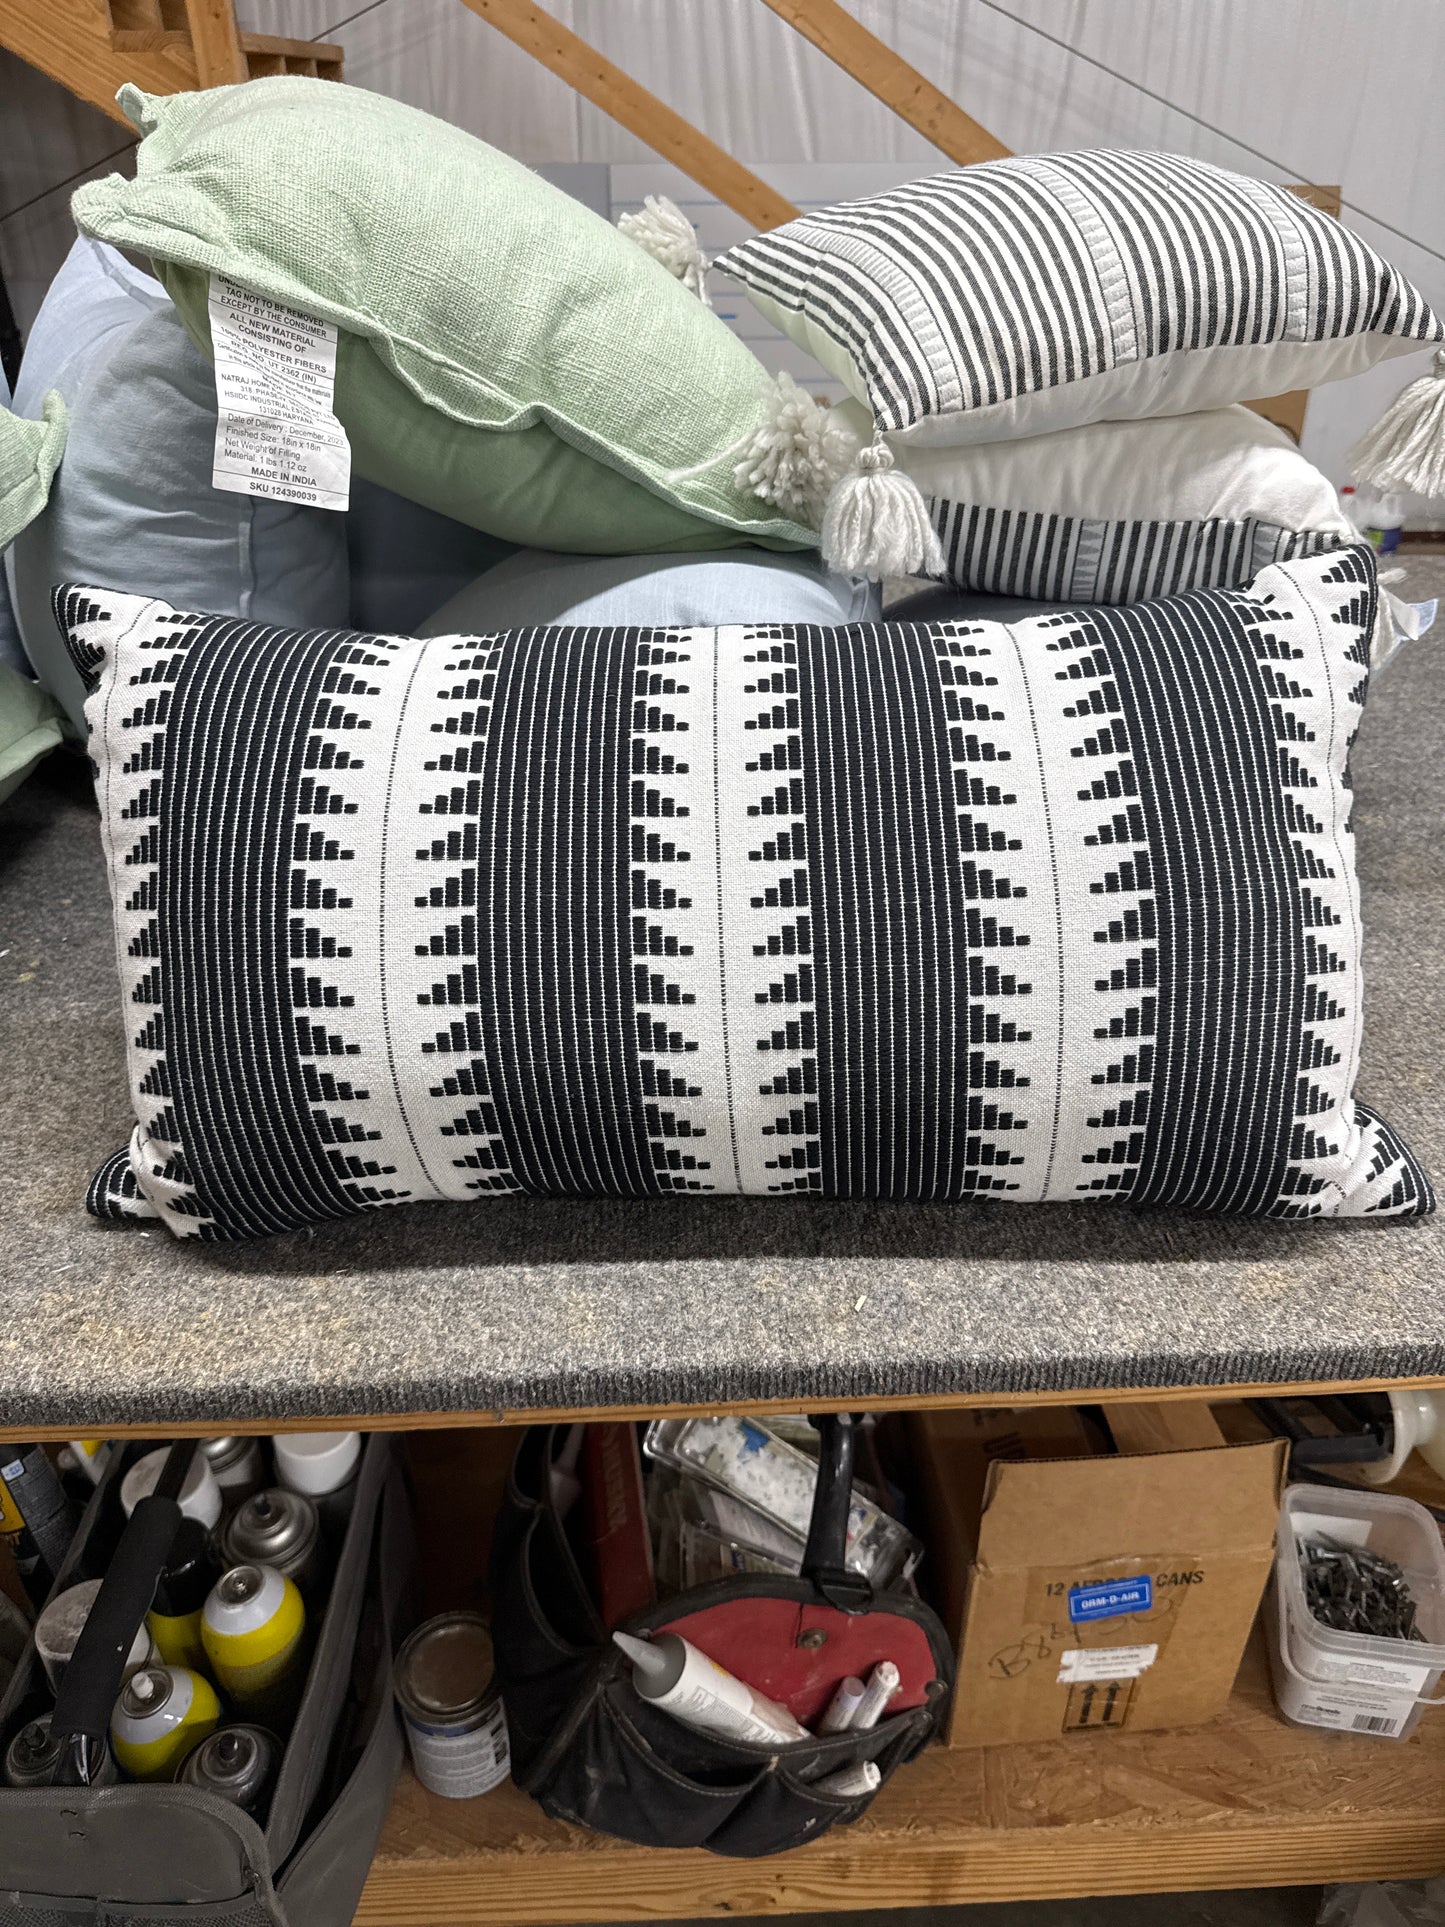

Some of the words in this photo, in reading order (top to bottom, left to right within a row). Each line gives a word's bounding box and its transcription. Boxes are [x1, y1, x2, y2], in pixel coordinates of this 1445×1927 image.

[220, 295, 252, 312] EXCEPT
[253, 306, 266, 317] BY
[266, 311, 282, 322] THE
[283, 316, 327, 338] CONSUMER
[225, 286, 242, 299] TAG
[243, 293, 261, 305] NOT
[262, 299, 273, 309] TO
[274, 303, 285, 314] BE
[286, 307, 324, 328] REMOVED
[229, 312, 247, 325] ALL
[248, 318, 271, 332] NEW
[271, 326, 316, 348] MATERIAL
[238, 324, 293, 350] CONSISTING
[294, 343, 307, 354] OF
[242, 337, 293, 364] POLYESTER
[294, 357, 327, 374] FIBERS
[221, 373, 250, 385] NATRAJ
[268, 359, 279, 370] UT
[281, 365, 300, 379] 2362
[301, 371, 317, 384] (IN)
[249, 395, 290, 411] INDUSTRIAL
[258, 405, 282, 417] 131028
[282, 410, 314, 425] HARYANA
[226, 425, 259, 440] Finished
[260, 432, 280, 444] Size:
[281, 436, 298, 448] 18in
[299, 441, 304, 449] x
[305, 441, 321, 452] 18in
[227, 412, 246, 424] Date
[246, 417, 254, 426] of
[255, 418, 284, 433] Delivery
[289, 426, 326, 442] December,
[224, 448, 256, 462] Material:
[259, 456, 264, 464] 1
[265, 456, 277, 467] lbs
[279, 460, 296, 471] 1.12
[297, 464, 307, 473] oz
[225, 437, 240, 448] Net
[241, 440, 268, 455] Weight
[268, 446, 277, 455] of
[278, 447, 301, 461] Filling
[251, 466, 278, 480] MADE
[279, 472, 290, 482] IN
[291, 475, 317, 487] INDIA
[249, 481, 269, 493] SKU
[271, 486, 317, 502] 124390039
[1044, 1581, 1065, 1598] 12
[1155, 1569, 1205, 1589] CANS
